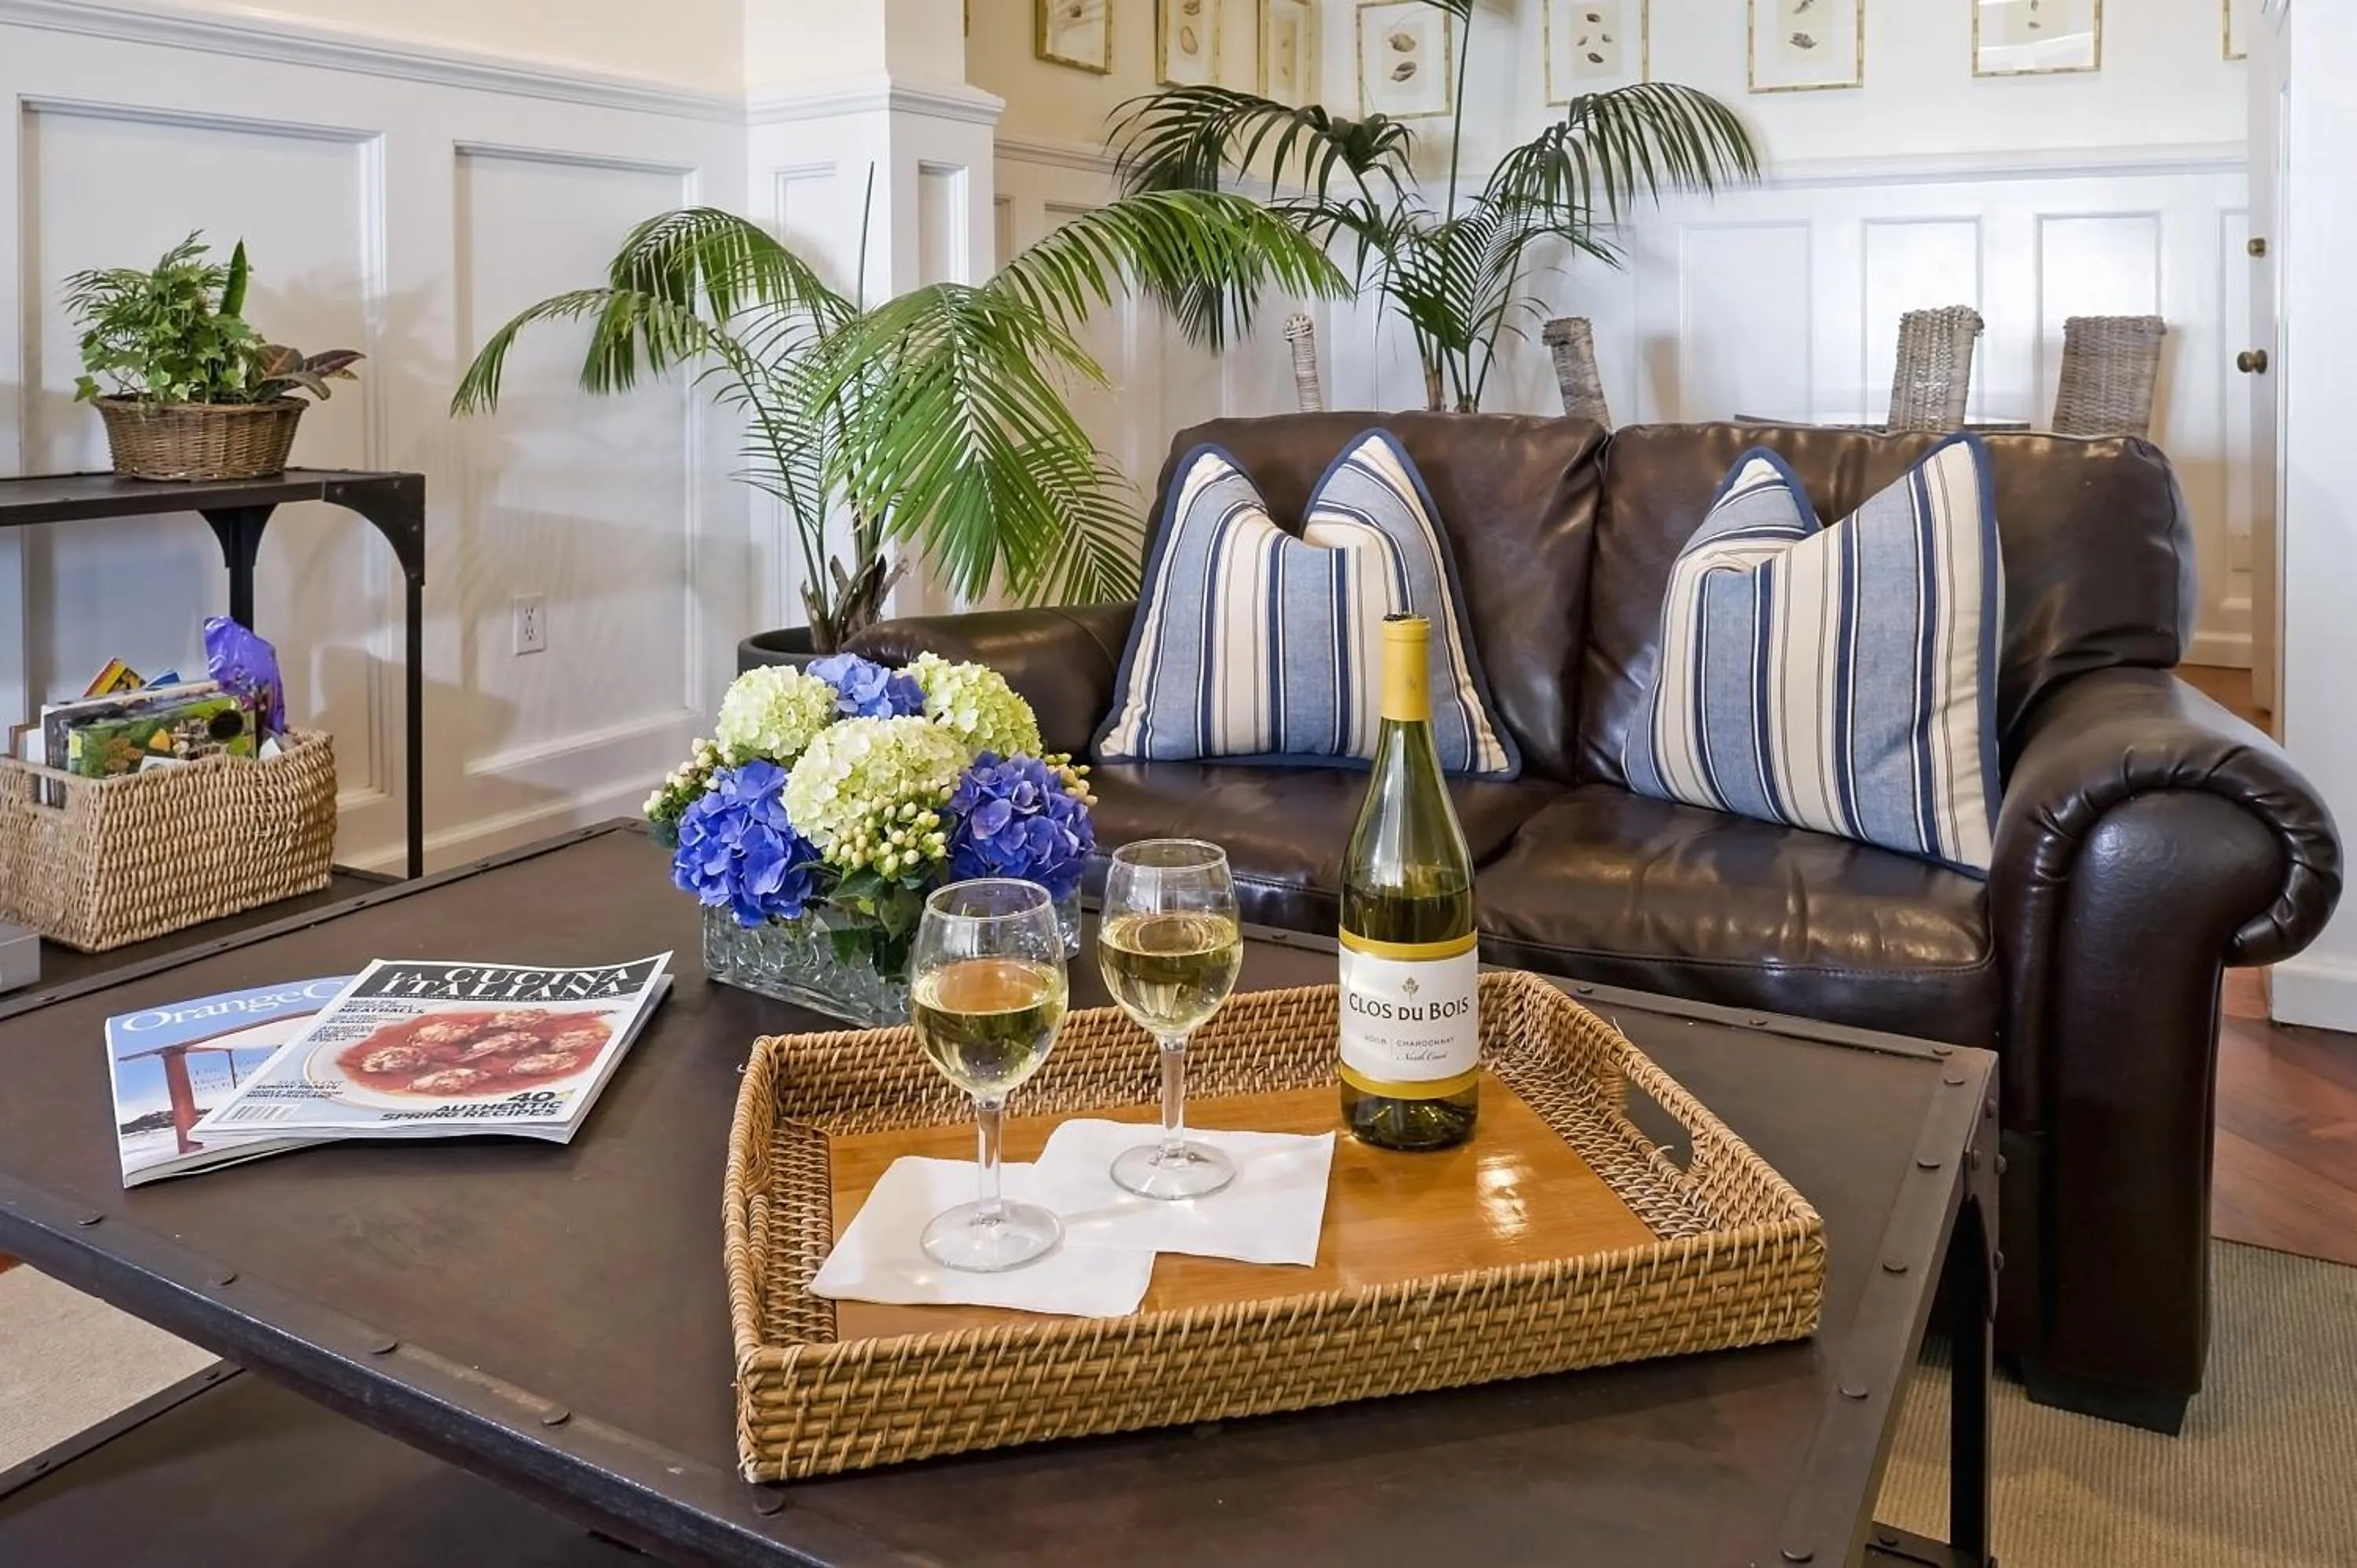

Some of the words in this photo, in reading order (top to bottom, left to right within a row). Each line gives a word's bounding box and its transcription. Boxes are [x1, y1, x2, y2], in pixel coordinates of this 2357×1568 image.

[391, 972, 425, 981] LA
[444, 967, 629, 987] CUCINA
[379, 979, 624, 998] ITALIANA
[1349, 993, 1392, 1020] CLOS
[1398, 1006, 1423, 1020] DU
[1430, 996, 1468, 1020] BOIS
[1396, 1036, 1454, 1047] CHARDONNAY
[507, 1091, 555, 1102] 40
[436, 1101, 563, 1112] AUTHENTIC
[380, 1111, 459, 1121] SPRING
[462, 1108, 559, 1119] RECIPES
